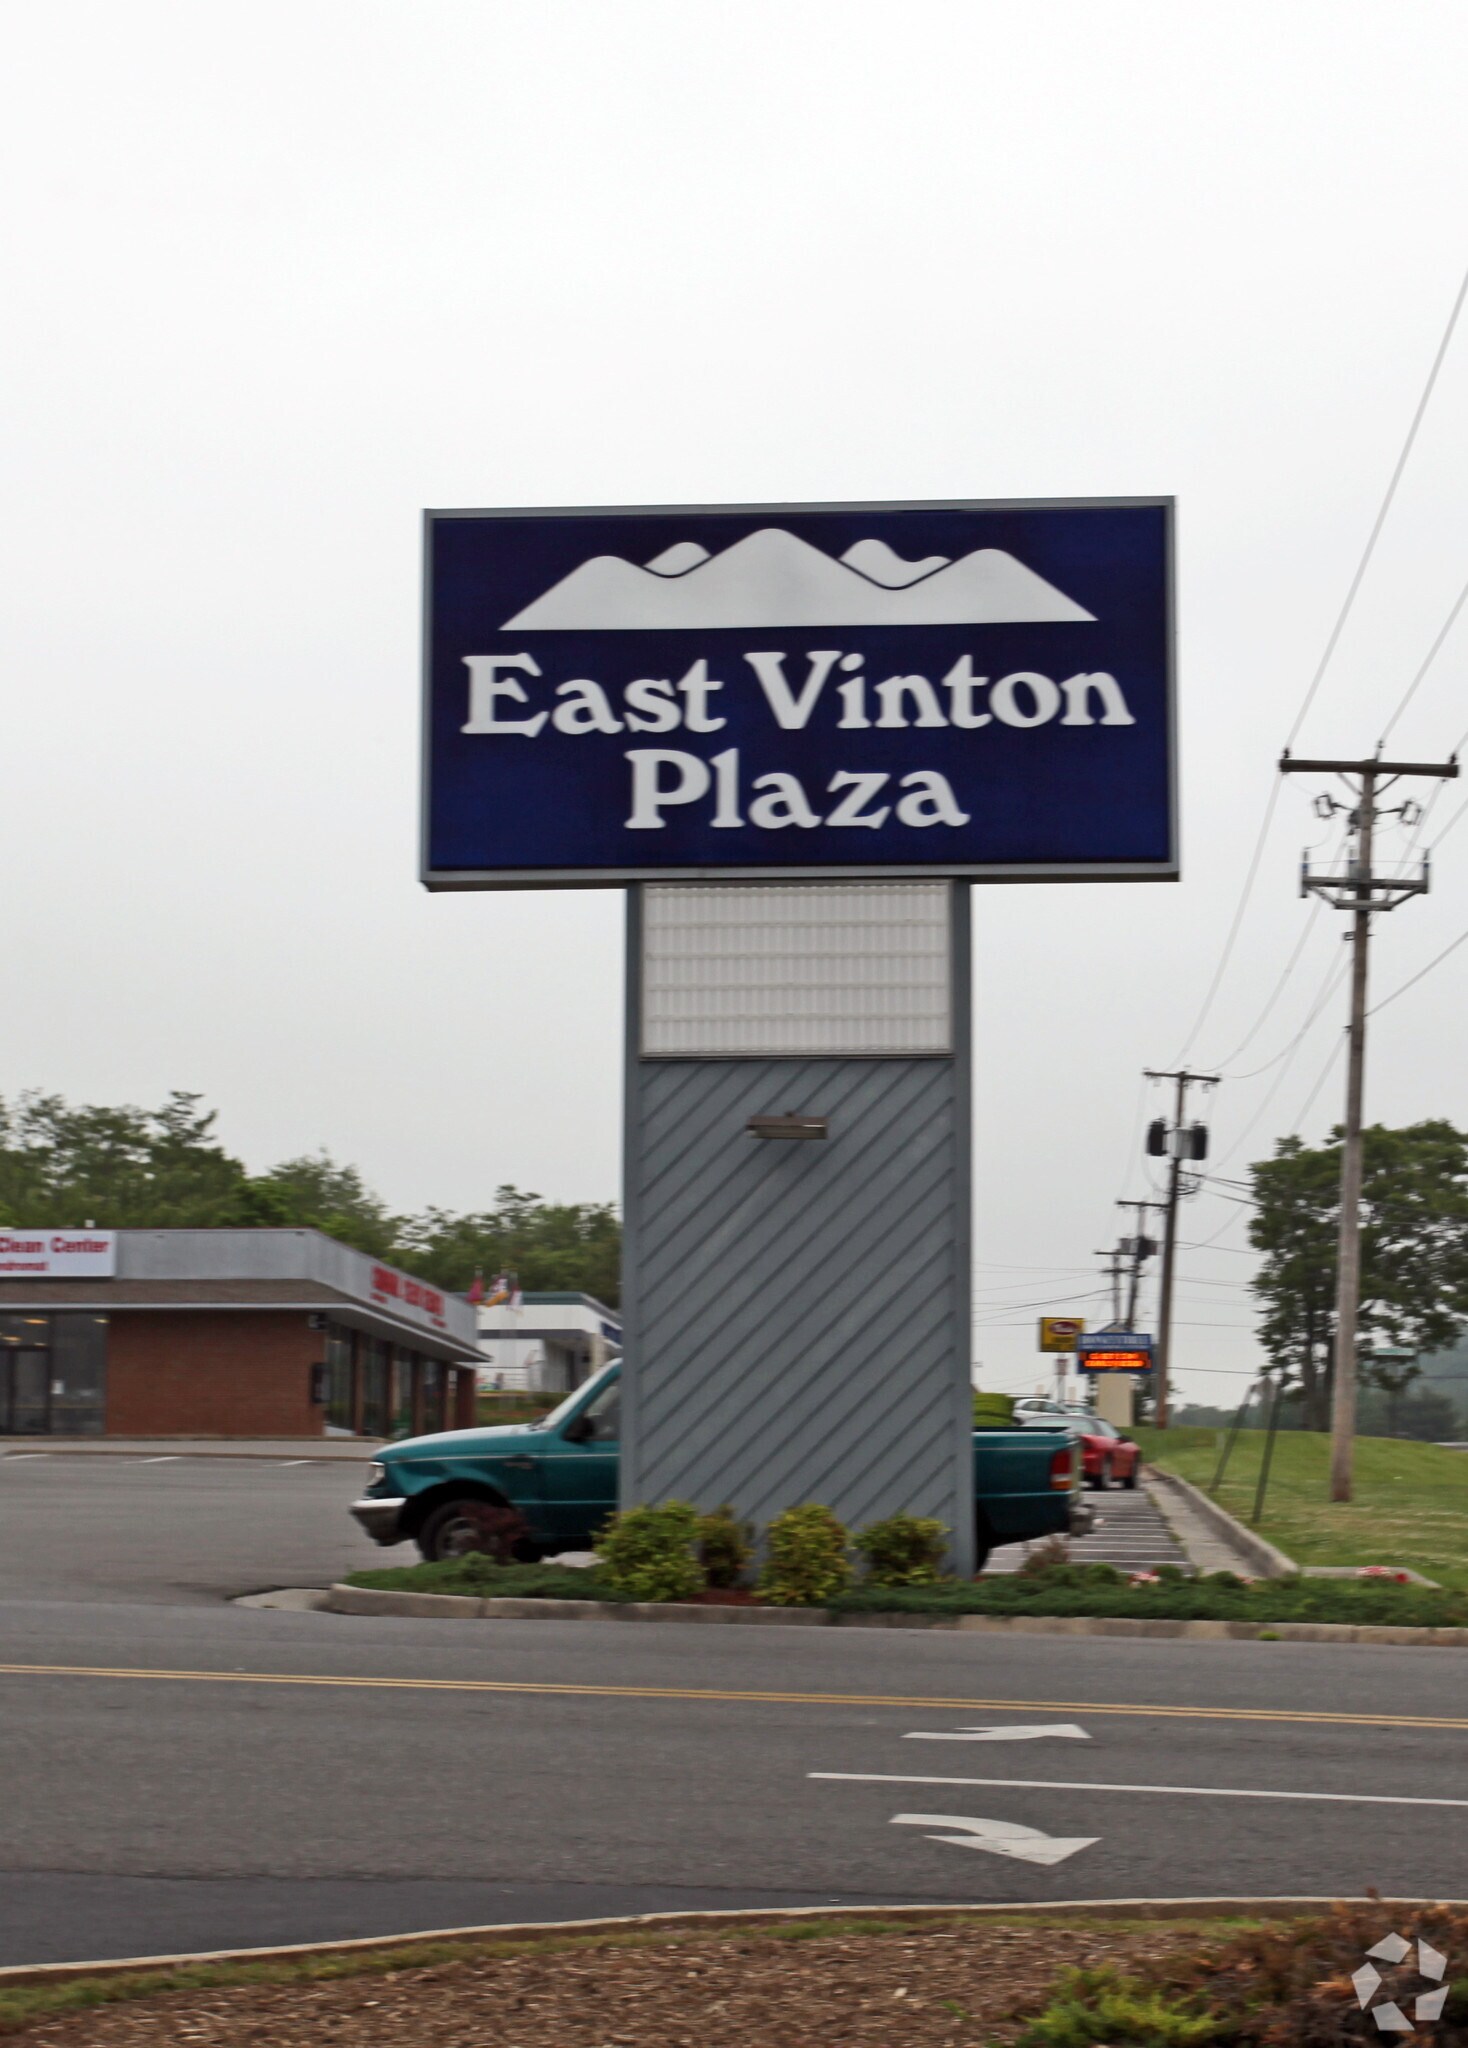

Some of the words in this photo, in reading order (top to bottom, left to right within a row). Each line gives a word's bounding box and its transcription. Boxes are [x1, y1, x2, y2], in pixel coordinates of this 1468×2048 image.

[461, 652, 727, 738] East
[744, 650, 1136, 730] Vinton
[624, 748, 970, 830] Plaza
[51, 1236, 109, 1253] Center
